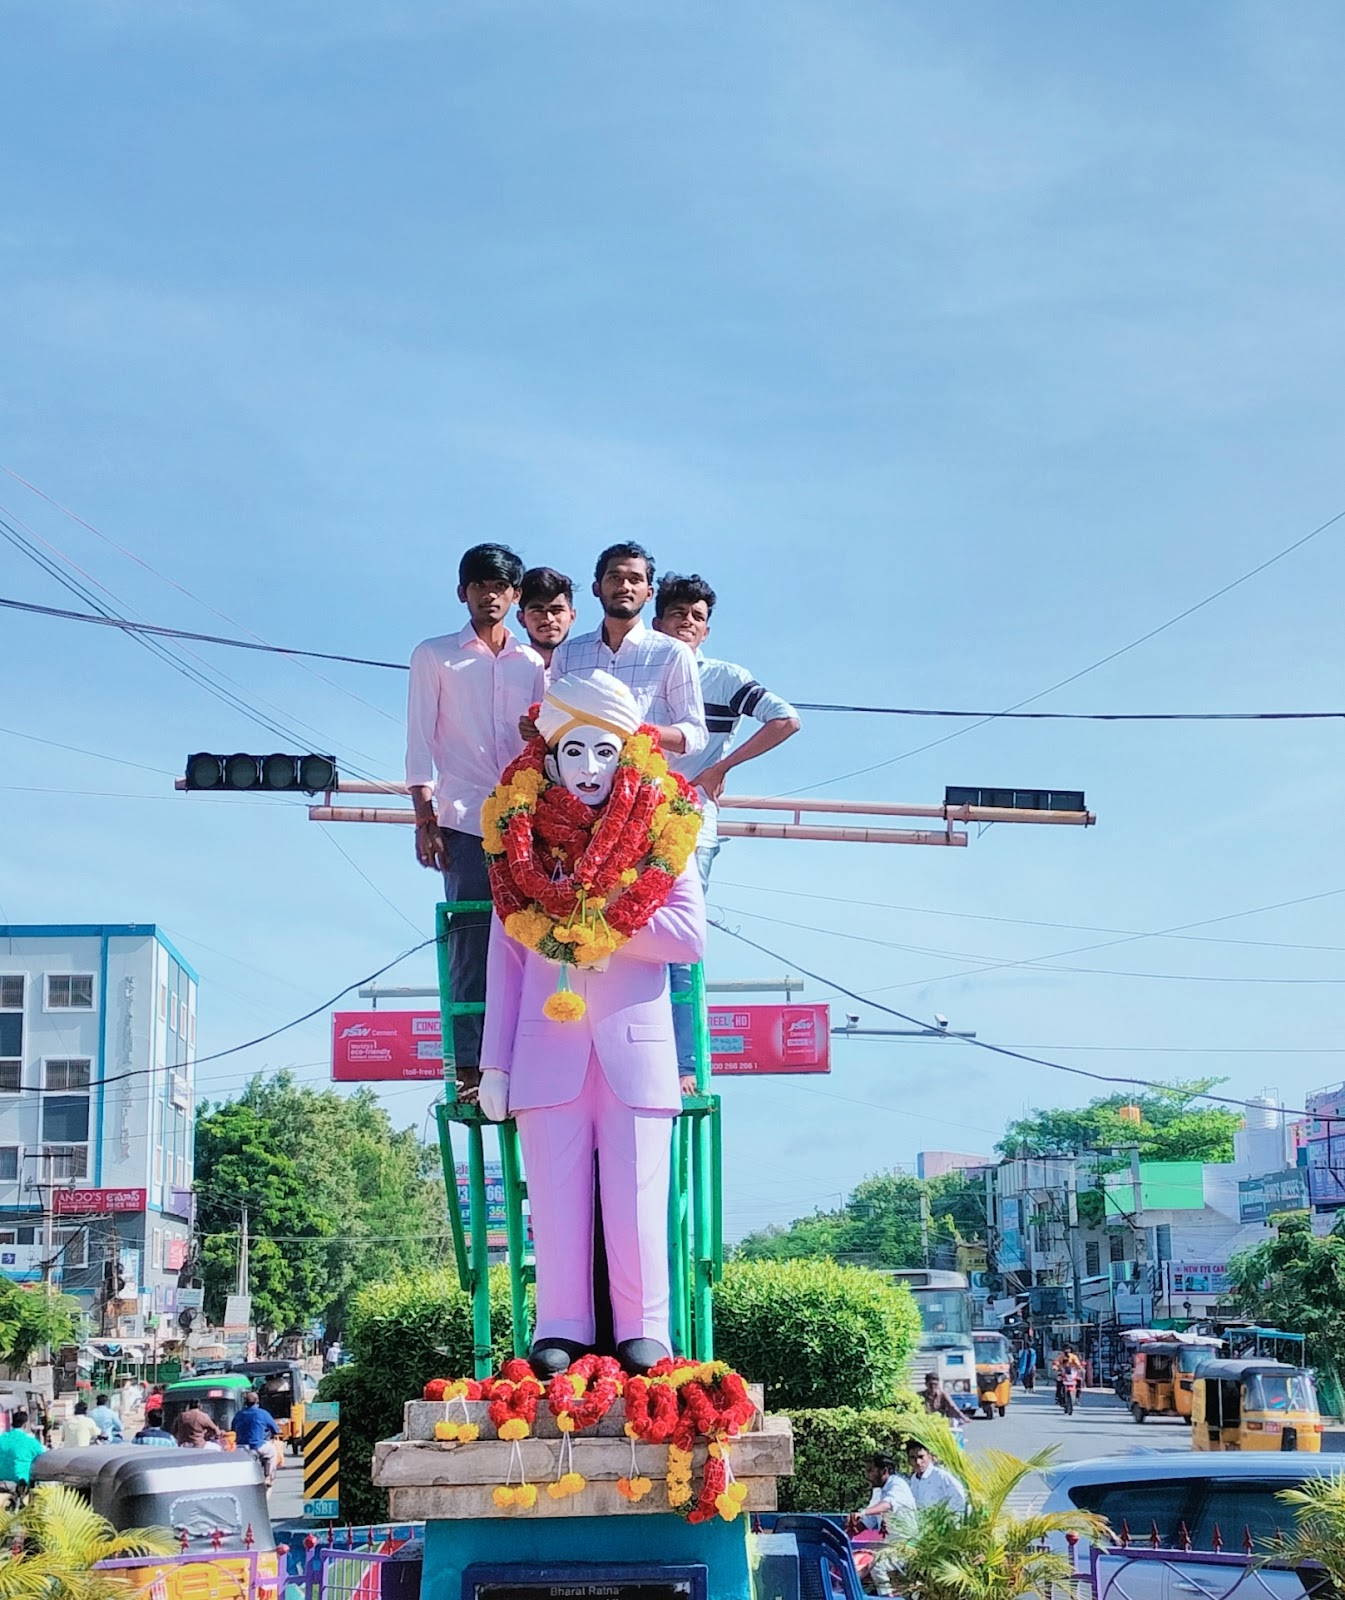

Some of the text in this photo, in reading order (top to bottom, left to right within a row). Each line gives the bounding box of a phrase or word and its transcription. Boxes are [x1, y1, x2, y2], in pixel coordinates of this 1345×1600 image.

[416, 1021, 442, 1031] CONC
[735, 1016, 747, 1026] HD
[338, 1023, 371, 1038] JSW
[350, 1048, 391, 1058] eco-friendly
[711, 1062, 723, 1070] 00
[402, 1068, 436, 1077] (toll-free)
[1183, 1265, 1198, 1273] NEW
[1200, 1265, 1211, 1273] EYE
[550, 1585, 620, 1597] Bharat Ratna
